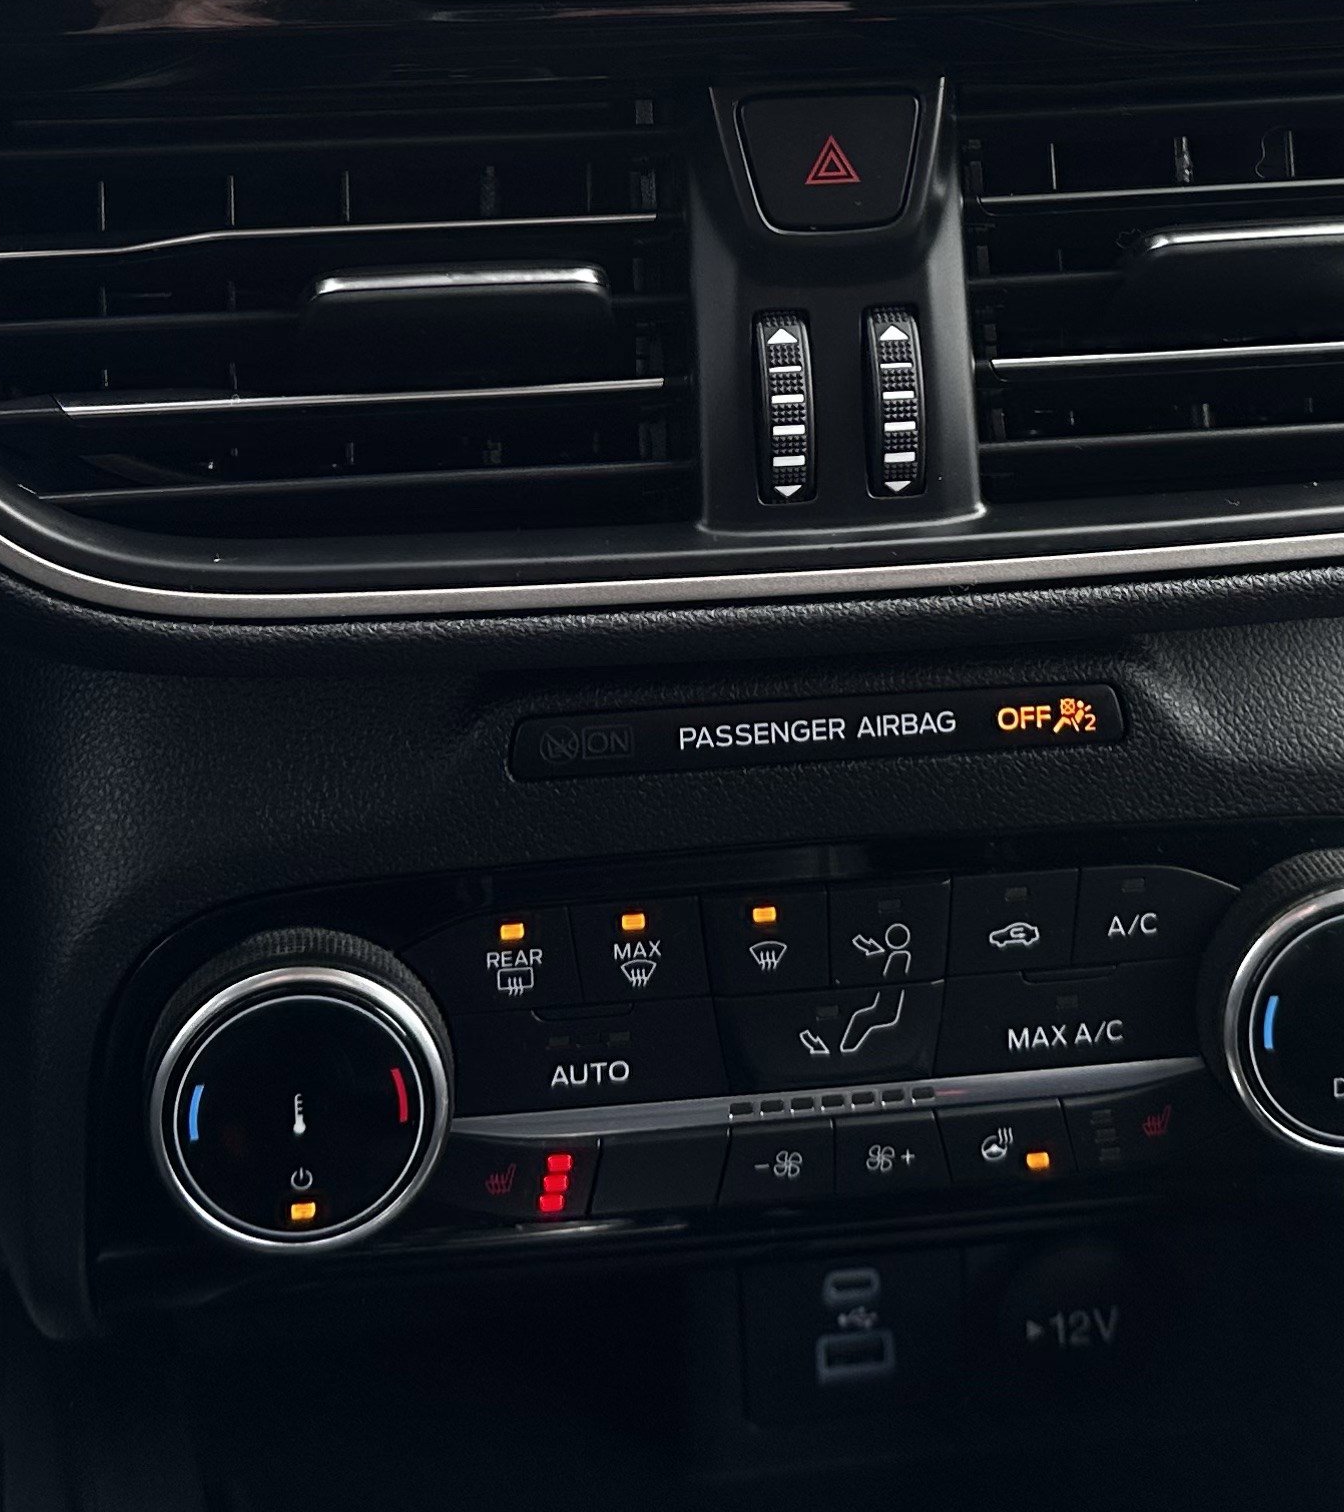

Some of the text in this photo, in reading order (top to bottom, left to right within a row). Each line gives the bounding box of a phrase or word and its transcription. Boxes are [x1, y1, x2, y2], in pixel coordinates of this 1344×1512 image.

[678, 709, 958, 752] PASSENGER AIRBAG
[997, 705, 1052, 731] OFF
[1106, 911, 1158, 938] A/C
[485, 948, 543, 970] REAR
[612, 939, 662, 961] MAX
[1006, 1018, 1124, 1051] MAX A/C
[549, 1059, 631, 1088] AUTO
[1050, 1306, 1119, 1346] 12V
